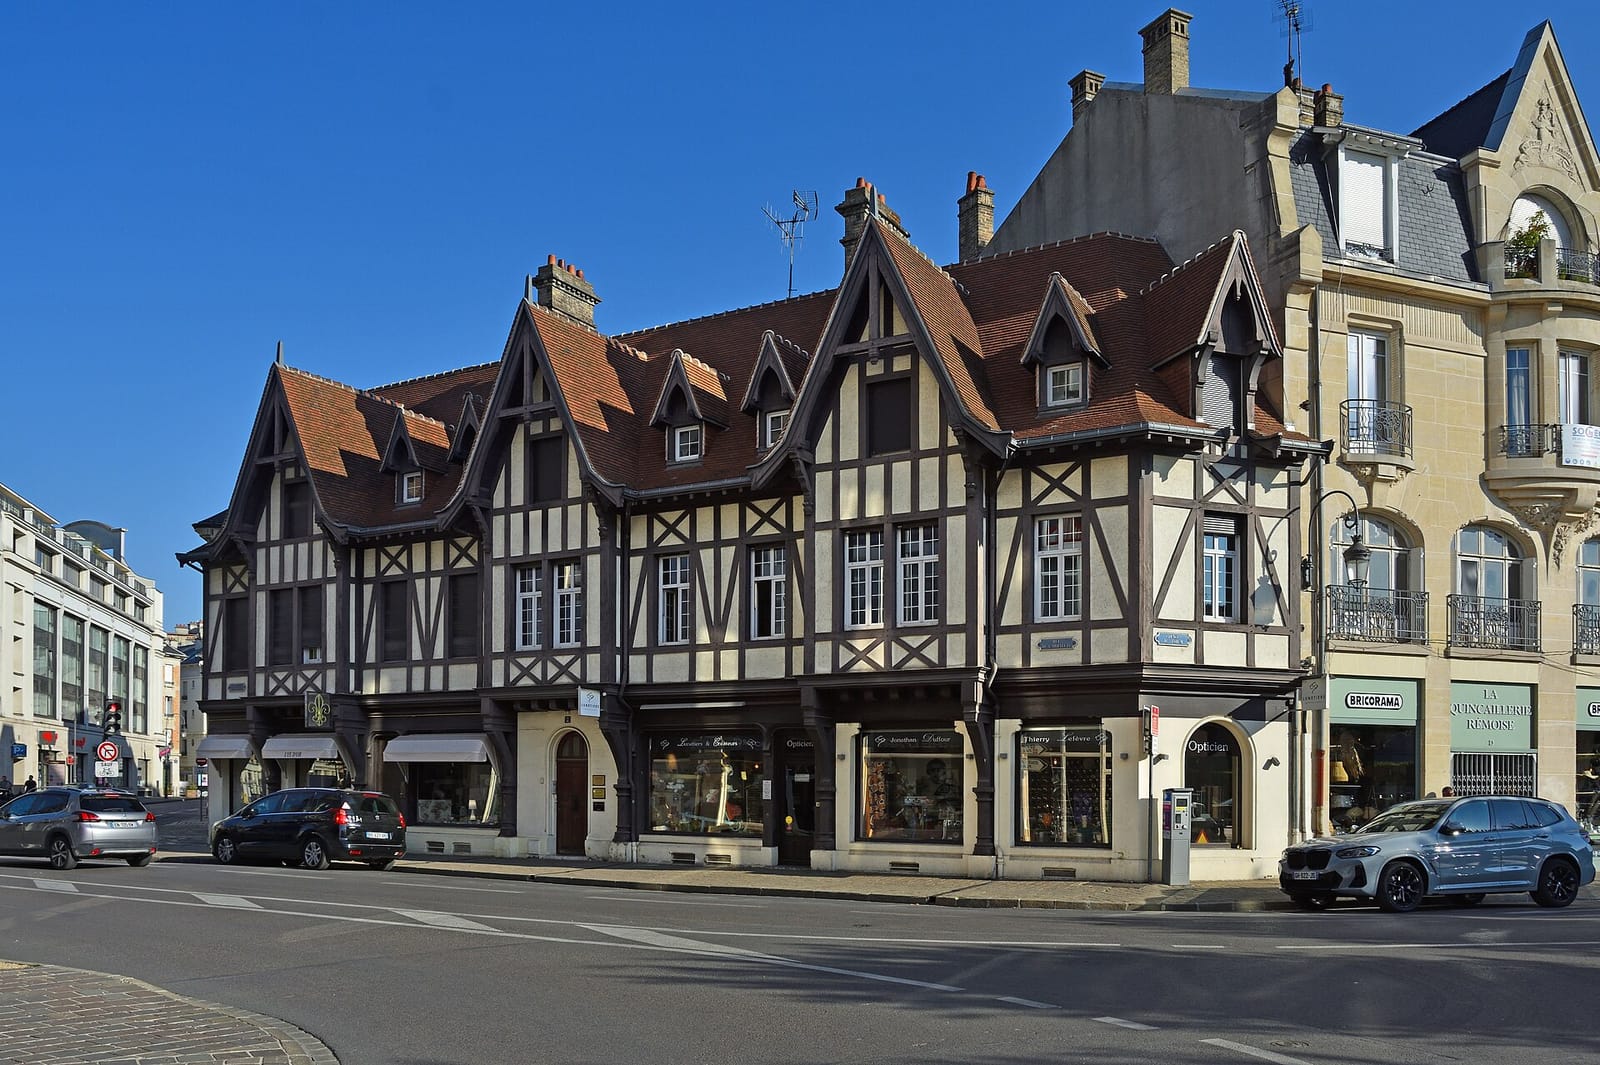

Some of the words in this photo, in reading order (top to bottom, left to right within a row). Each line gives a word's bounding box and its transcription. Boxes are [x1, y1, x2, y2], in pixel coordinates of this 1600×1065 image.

[1483, 689, 1497, 700] LA
[1350, 695, 1400, 707] BRICORAMA
[1450, 703, 1533, 717] QUINCAILLERIE
[1466, 717, 1514, 731] RÉMOISE
[889, 736, 917, 744] Jonathan
[1023, 736, 1050, 744] Thierry
[1188, 740, 1229, 753] Opticien
